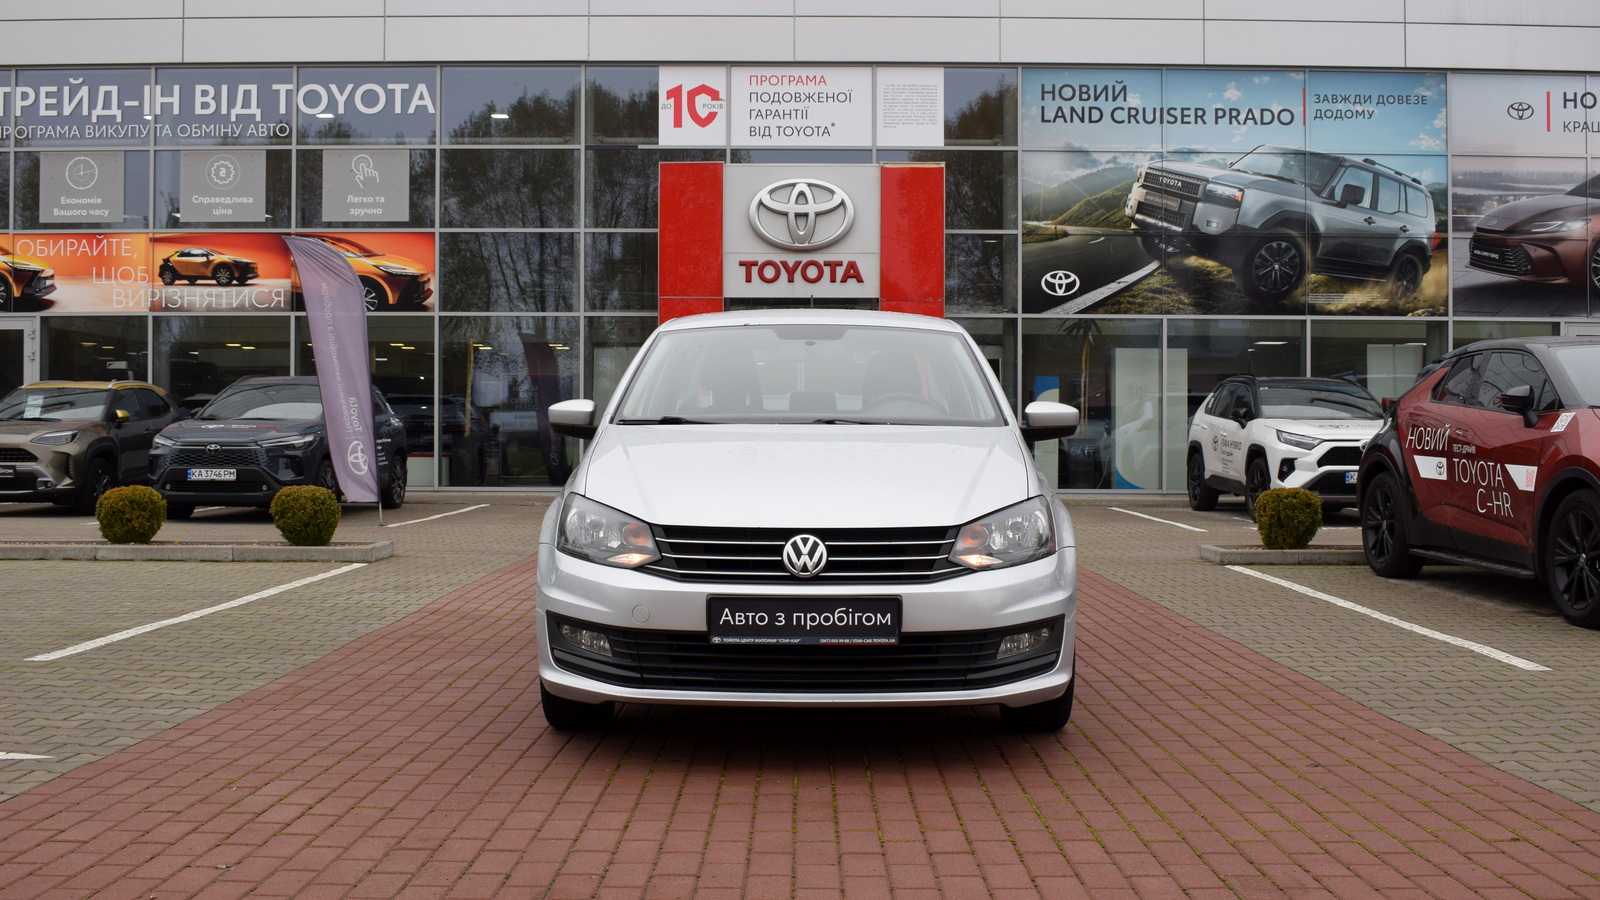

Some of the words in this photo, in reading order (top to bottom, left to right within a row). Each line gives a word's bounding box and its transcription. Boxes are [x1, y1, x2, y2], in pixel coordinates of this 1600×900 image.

[749, 75, 827, 86] ПРОГРАМА
[749, 89, 853, 104] ПОДОВЖЕНОЇ
[1041, 80, 1128, 102] НОВИЙ
[195, 84, 262, 122] ВІД
[273, 83, 436, 115] TOYOTA
[1314, 93, 1372, 106] ЗАВЖДИ
[1375, 94, 1428, 107] ДОВЕЗЕ
[749, 107, 809, 120] ГАРАНТІЇ
[1041, 106, 1103, 124] LAND
[1110, 107, 1207, 125] CRUISER
[1214, 107, 1295, 126] PRADO
[1314, 108, 1375, 121] ДОДОМУ
[0, 125, 80, 139] РОГРАМА
[85, 125, 150, 138] ВИКУПУ
[155, 125, 173, 137] ТА
[177, 124, 242, 138] ОБМІНУ
[247, 123, 290, 137] АВТО
[749, 126, 772, 139] ВІД
[1159, 177, 1181, 187] TOYOTA
[60, 196, 102, 205] Економія
[192, 196, 253, 206] Справедлива
[347, 195, 371, 204] Легко
[374, 196, 385, 204] та
[53, 208, 82, 217] Вашого
[84, 209, 109, 218] часу
[213, 207, 233, 217] ціна
[349, 207, 383, 217] зручно
[16, 235, 138, 258] ОБИРАЙТЕ,
[92, 266, 149, 286] ЩОБ
[739, 260, 864, 283] TOYOTA
[113, 288, 285, 309] ВИРІЗНЯТИСЯ
[1406, 424, 1450, 451] НОВИЙ
[1453, 458, 1504, 488] TOYOTA
[1476, 488, 1513, 518] C-HR
[719, 607, 769, 625] Авто
[775, 612, 786, 626] з
[793, 607, 891, 630] пробігом
